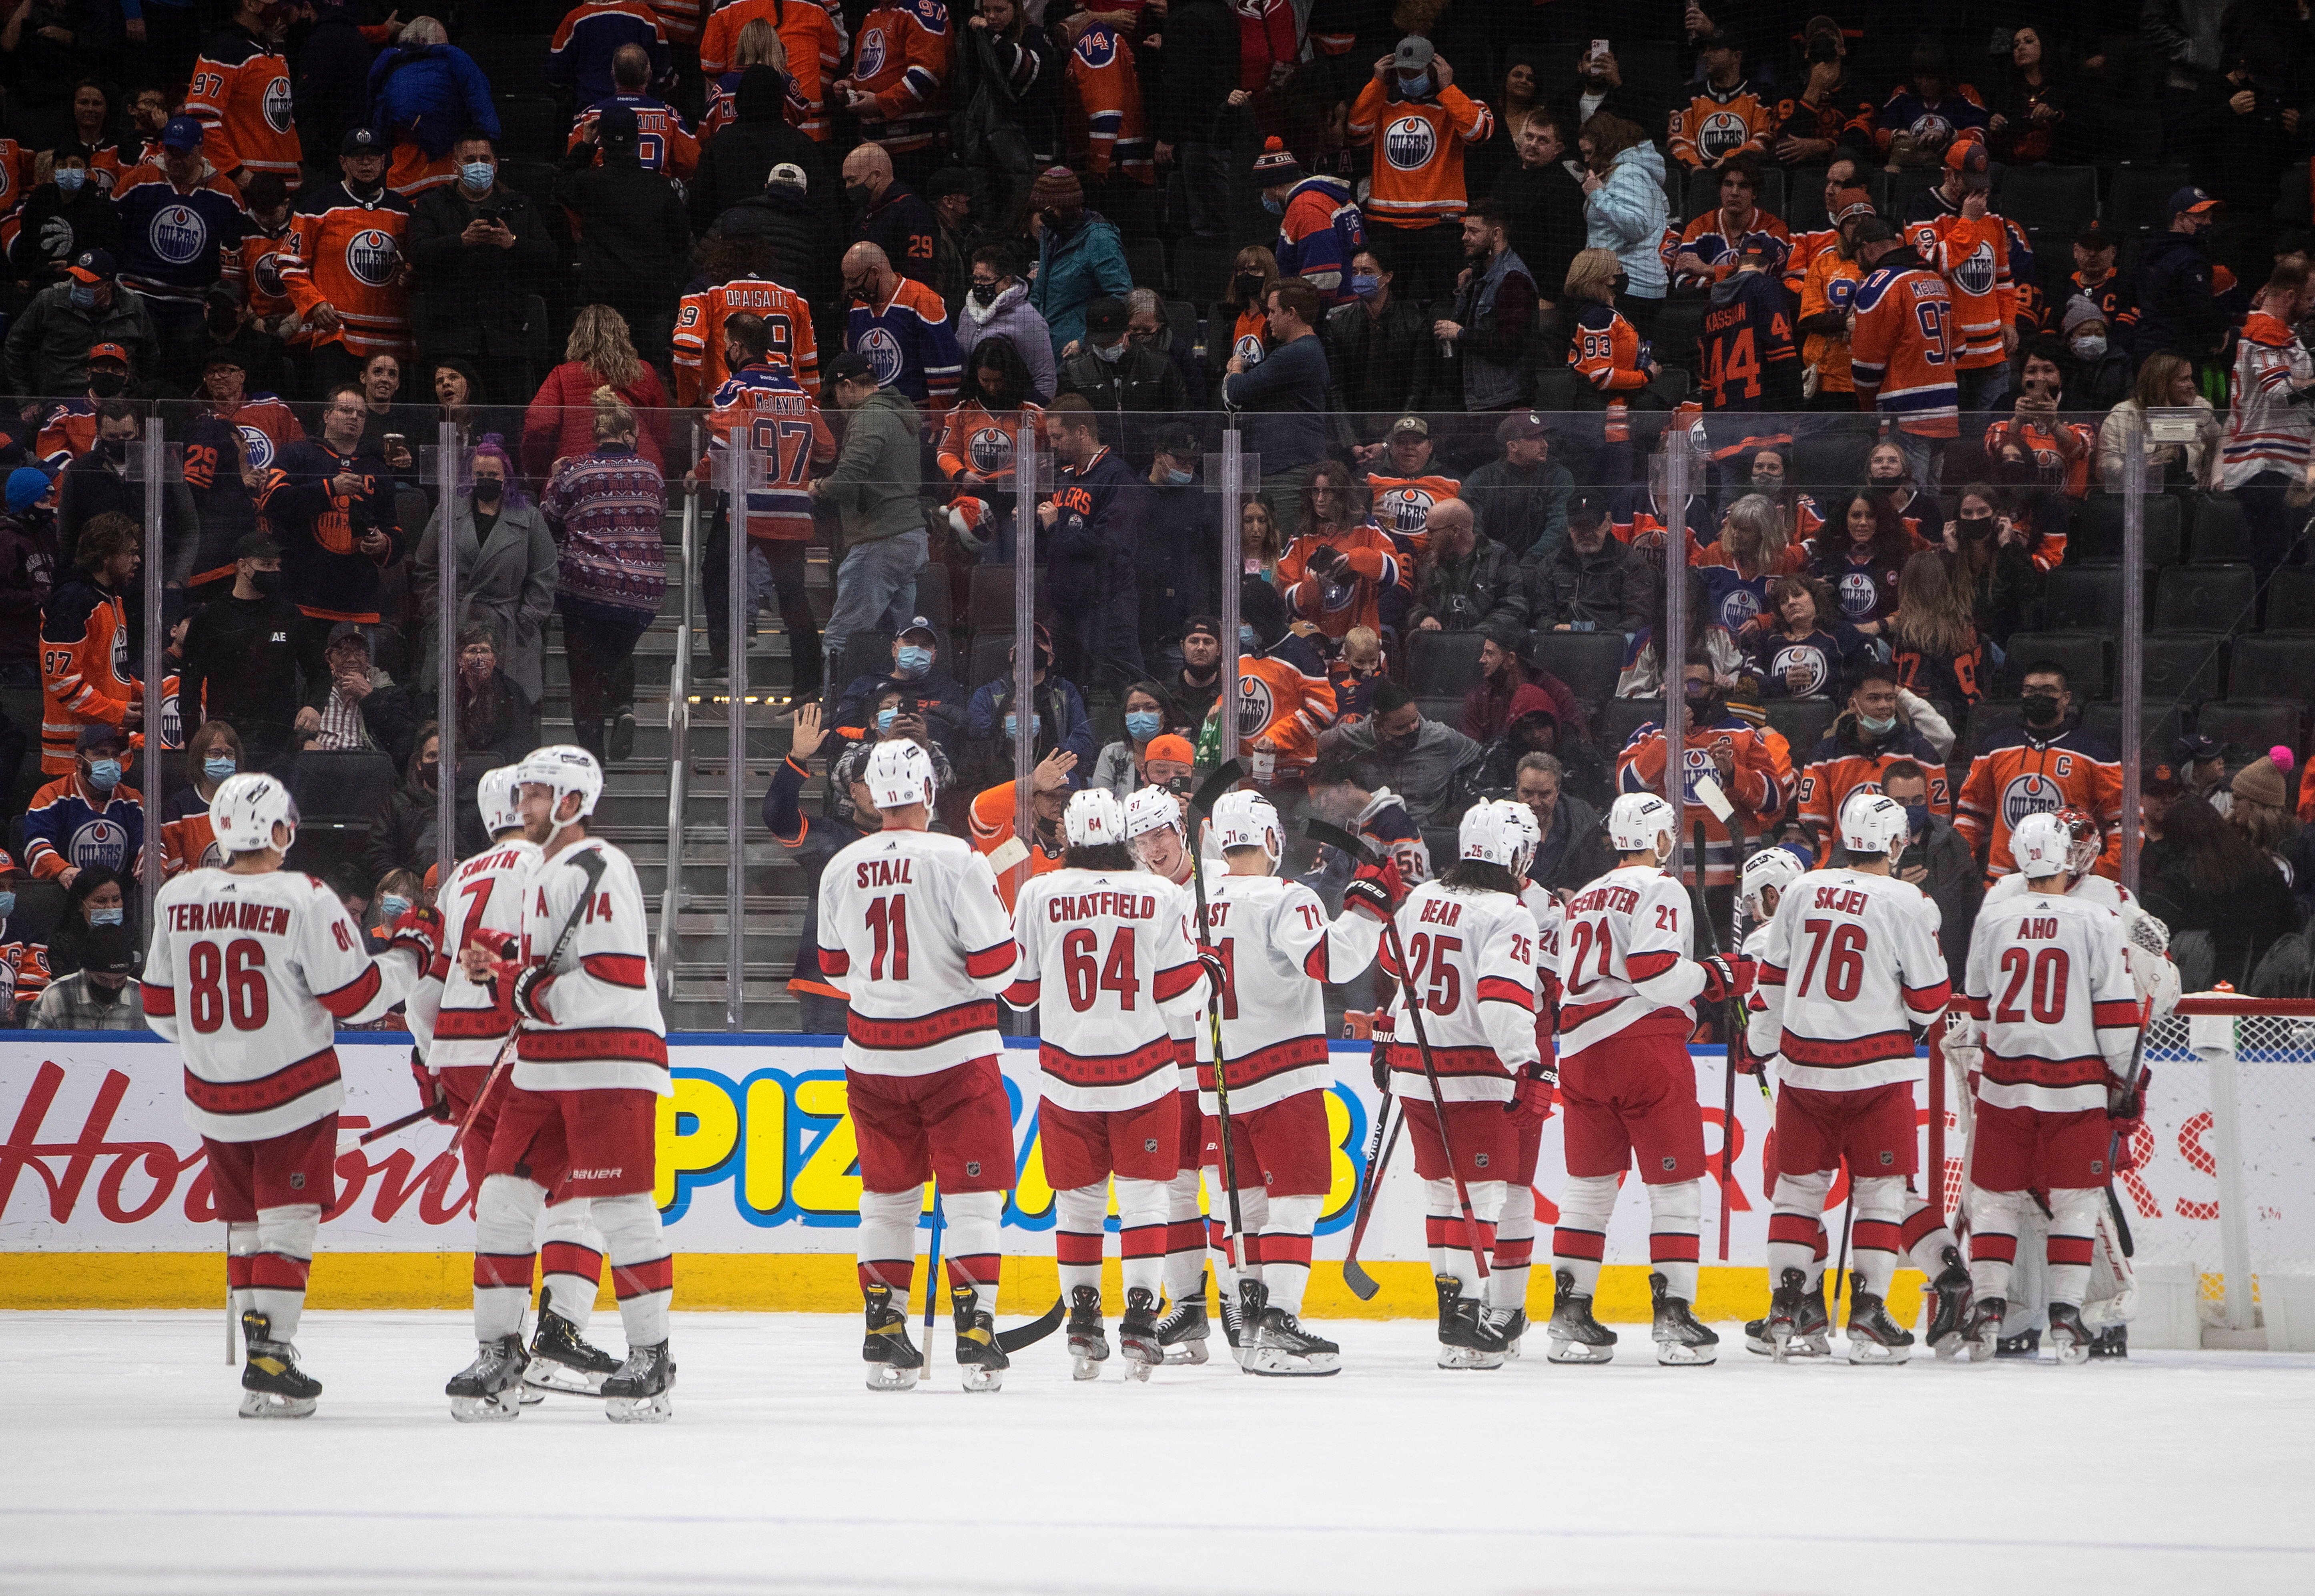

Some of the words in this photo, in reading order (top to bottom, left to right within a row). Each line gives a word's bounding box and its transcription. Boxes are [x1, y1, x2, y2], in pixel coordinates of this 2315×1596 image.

[1077, 32, 1108, 56] 74
[193, 73, 223, 97] 97
[1389, 135, 1428, 152] OILERS
[159, 223, 198, 246] OILERS
[907, 235, 932, 258] 29
[725, 289, 789, 309] DRAISAITL
[2102, 293, 2116, 312] C
[862, 349, 894, 364] ILERS
[1583, 335, 1612, 359] 93
[1711, 326, 1762, 408] 44
[183, 444, 217, 477] 29
[750, 417, 813, 486] 97
[1052, 486, 1091, 515] ILERS
[271, 632, 287, 642] AE
[44, 650, 72, 676] 97
[2055, 759, 2072, 777] C
[887, 790, 897, 802] 11
[1798, 778, 1816, 804] 9
[1930, 778, 1950, 806] 2
[1089, 817, 1101, 831] 64
[1226, 830, 1236, 843] 71
[78, 844, 122, 861] OILERS
[1471, 844, 1482, 858] 25
[1618, 836, 1628, 848] 21
[1851, 836, 1863, 849] 76
[458, 850, 520, 882] SMITH
[857, 859, 913, 889] STAAL
[536, 886, 550, 918] A
[1049, 892, 1155, 923] CHATFIELD
[1420, 899, 1462, 928] BEAR
[1815, 886, 1869, 916] SKJEI
[167, 901, 291, 936] TERAVAINEN
[1295, 904, 1323, 931] 71
[1655, 905, 1678, 932] 21
[2017, 918, 2058, 940] AHO
[865, 894, 909, 982] 11
[1510, 933, 1532, 965] 25
[7, 949, 22, 969] C
[1062, 927, 1140, 1013] 64
[1568, 918, 1614, 997] 21
[1797, 919, 1868, 1003] 76
[189, 939, 269, 1034] 86
[1401, 932, 1462, 1017] 25
[1996, 948, 2070, 1025] 20
[572, 1167, 623, 1180] BAUER
